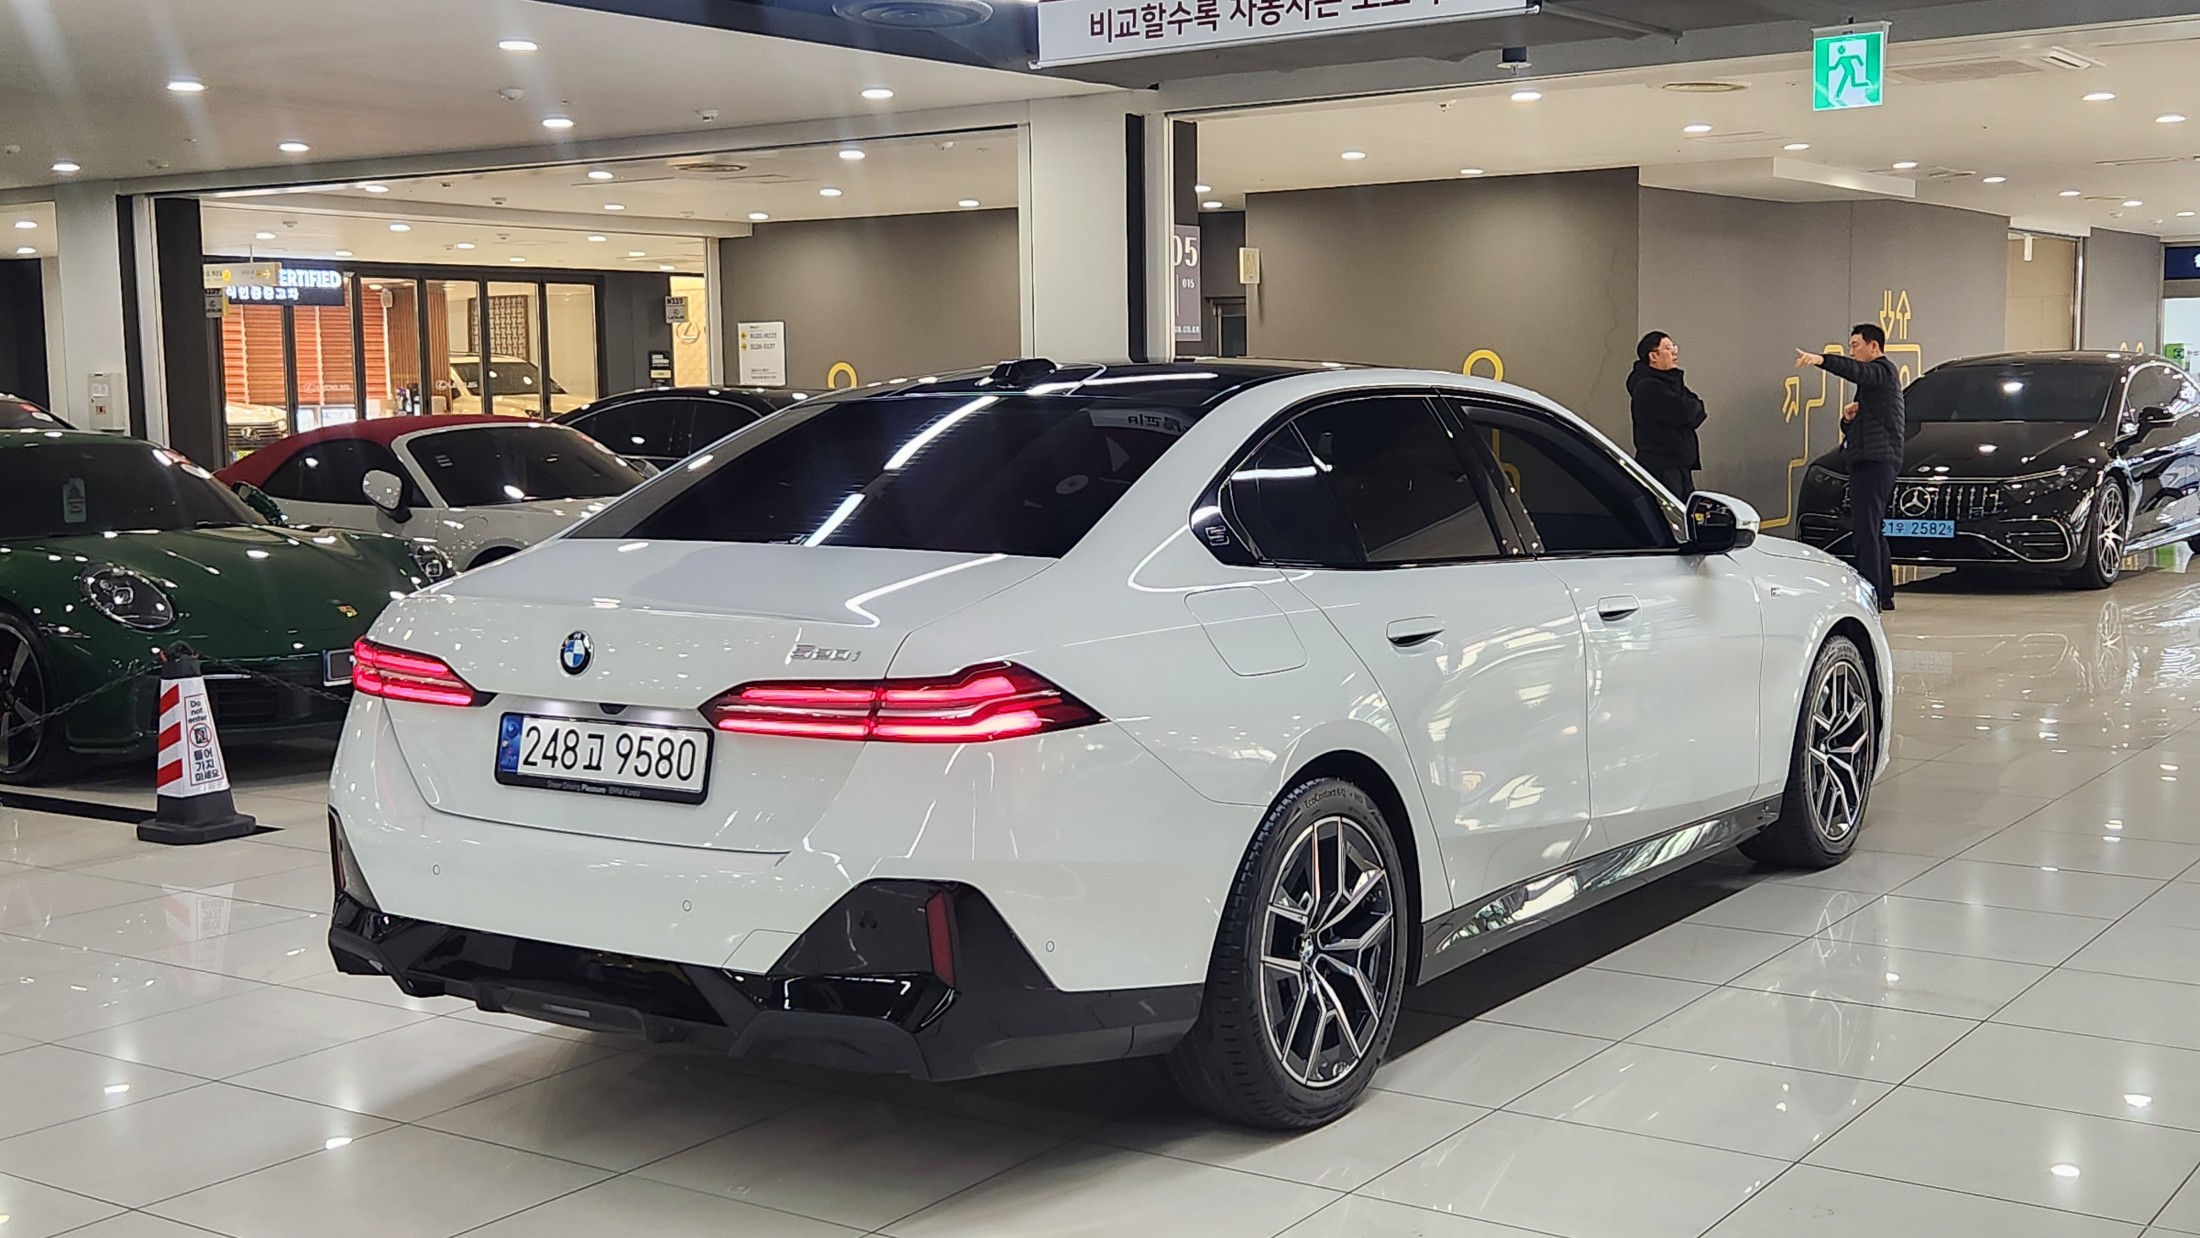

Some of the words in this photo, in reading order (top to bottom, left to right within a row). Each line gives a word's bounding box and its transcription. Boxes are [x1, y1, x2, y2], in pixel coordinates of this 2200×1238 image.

[1090, 0, 1220, 43] 비교할수록
[279, 269, 342, 288] ERTIFIED
[1182, 278, 1195, 289] 015
[1911, 522, 1947, 536] 2582
[190, 700, 201, 708] Do
[191, 707, 203, 716] not
[188, 715, 207, 724] enter
[523, 726, 605, 771] 248고
[616, 733, 696, 781] 9580
